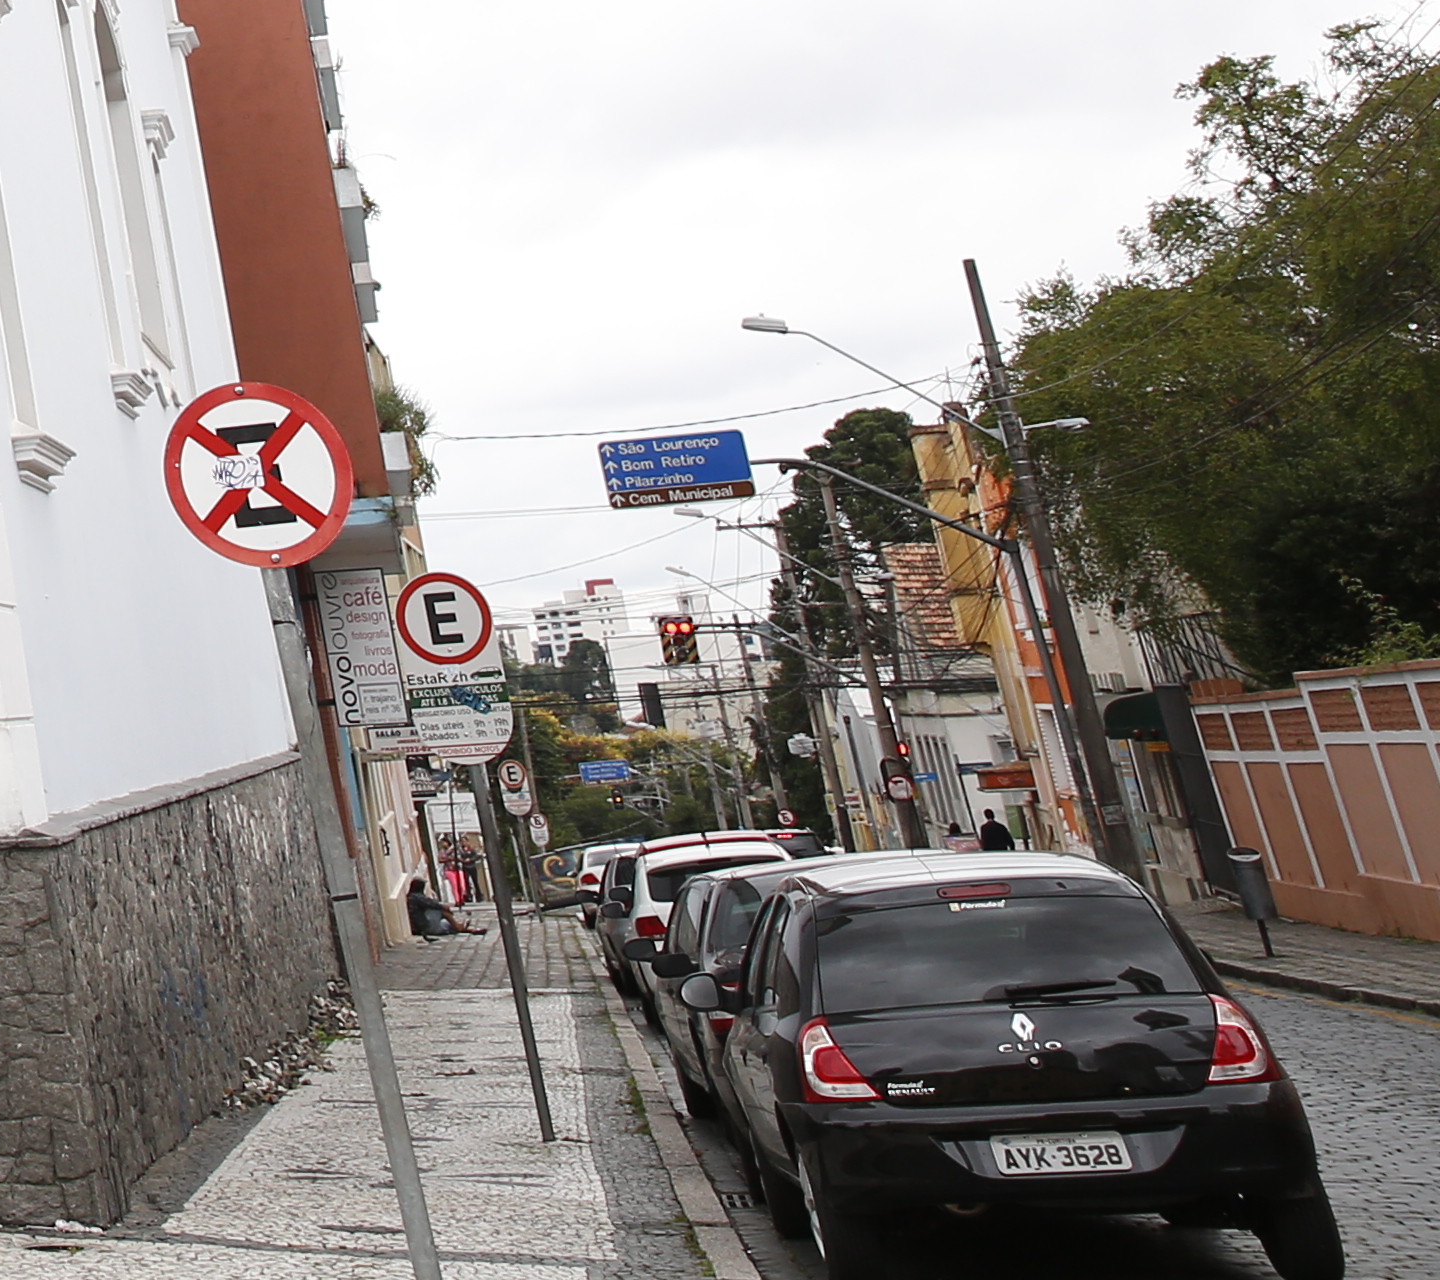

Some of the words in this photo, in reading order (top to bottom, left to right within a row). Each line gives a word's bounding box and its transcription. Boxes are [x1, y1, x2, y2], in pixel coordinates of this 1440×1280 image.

[618, 443, 645, 455] São
[653, 437, 719, 452] Lourenço
[622, 459, 654, 471] Bom
[661, 454, 705, 467] Retiro
[625, 473, 694, 488] Pilarzinho
[629, 493, 665, 505] Cem.
[669, 485, 733, 501] Municipal
[343, 587, 382, 607] café
[346, 611, 386, 625] design
[423, 592, 464, 645] E
[351, 629, 389, 640] fotografia
[365, 646, 393, 656] livros
[353, 660, 397, 676] moda
[407, 672, 448, 685] EstaR
[420, 723, 440, 731] Dias
[473, 719, 485, 727] 9h
[476, 729, 487, 737] 9h
[506, 766, 518, 782] E
[997, 1041, 1064, 1053] CLIO
